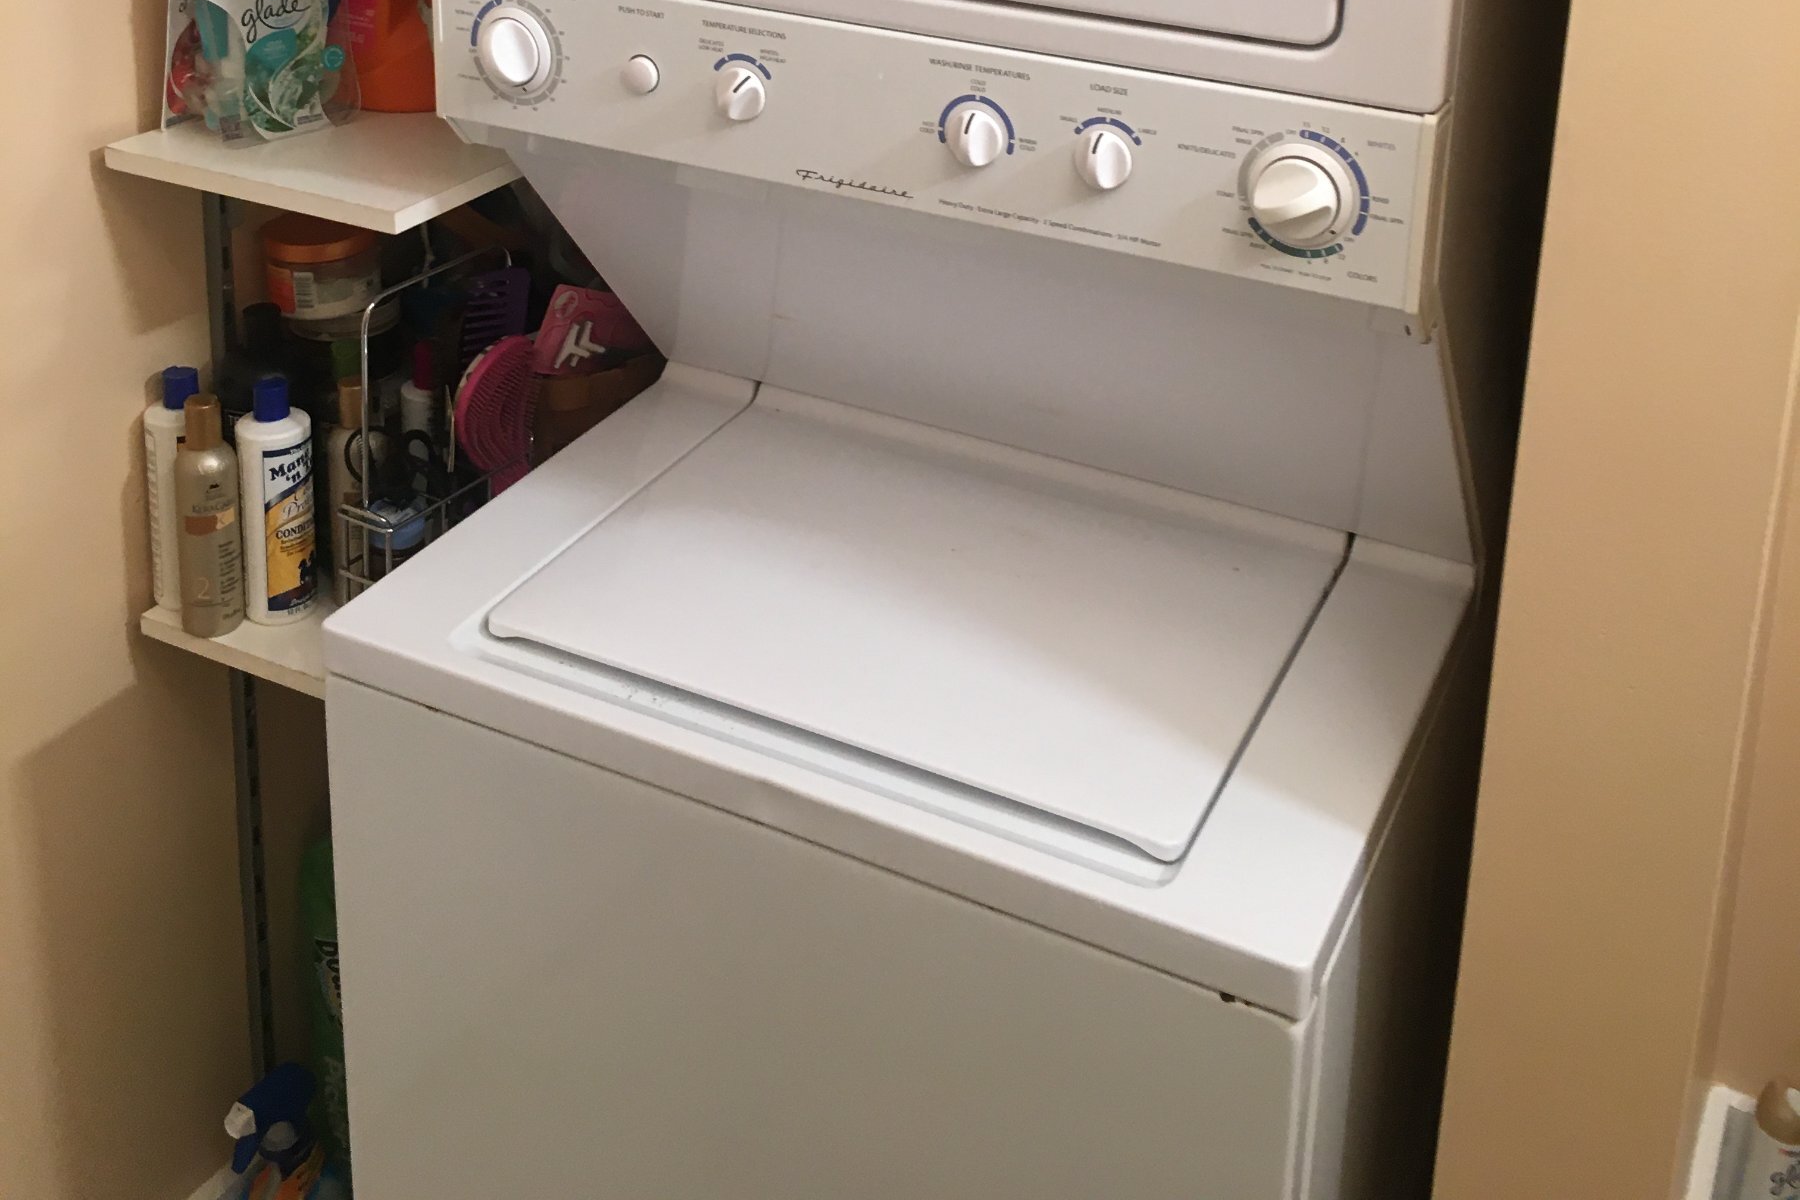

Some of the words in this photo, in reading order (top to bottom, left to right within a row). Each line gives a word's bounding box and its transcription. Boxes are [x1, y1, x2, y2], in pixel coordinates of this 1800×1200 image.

[618, 5, 635, 14] PUSH
[645, 9, 665, 19] START
[702, 19, 748, 34] TEMPERATURE
[749, 27, 787, 40] SELECTIONS
[975, 65, 1031, 81] TEMPERATURES
[1090, 83, 1112, 93] LOAD
[1113, 86, 1128, 96] SIZE
[796, 169, 914, 199] Frigidaire
[1346, 271, 1378, 283] COLORS
